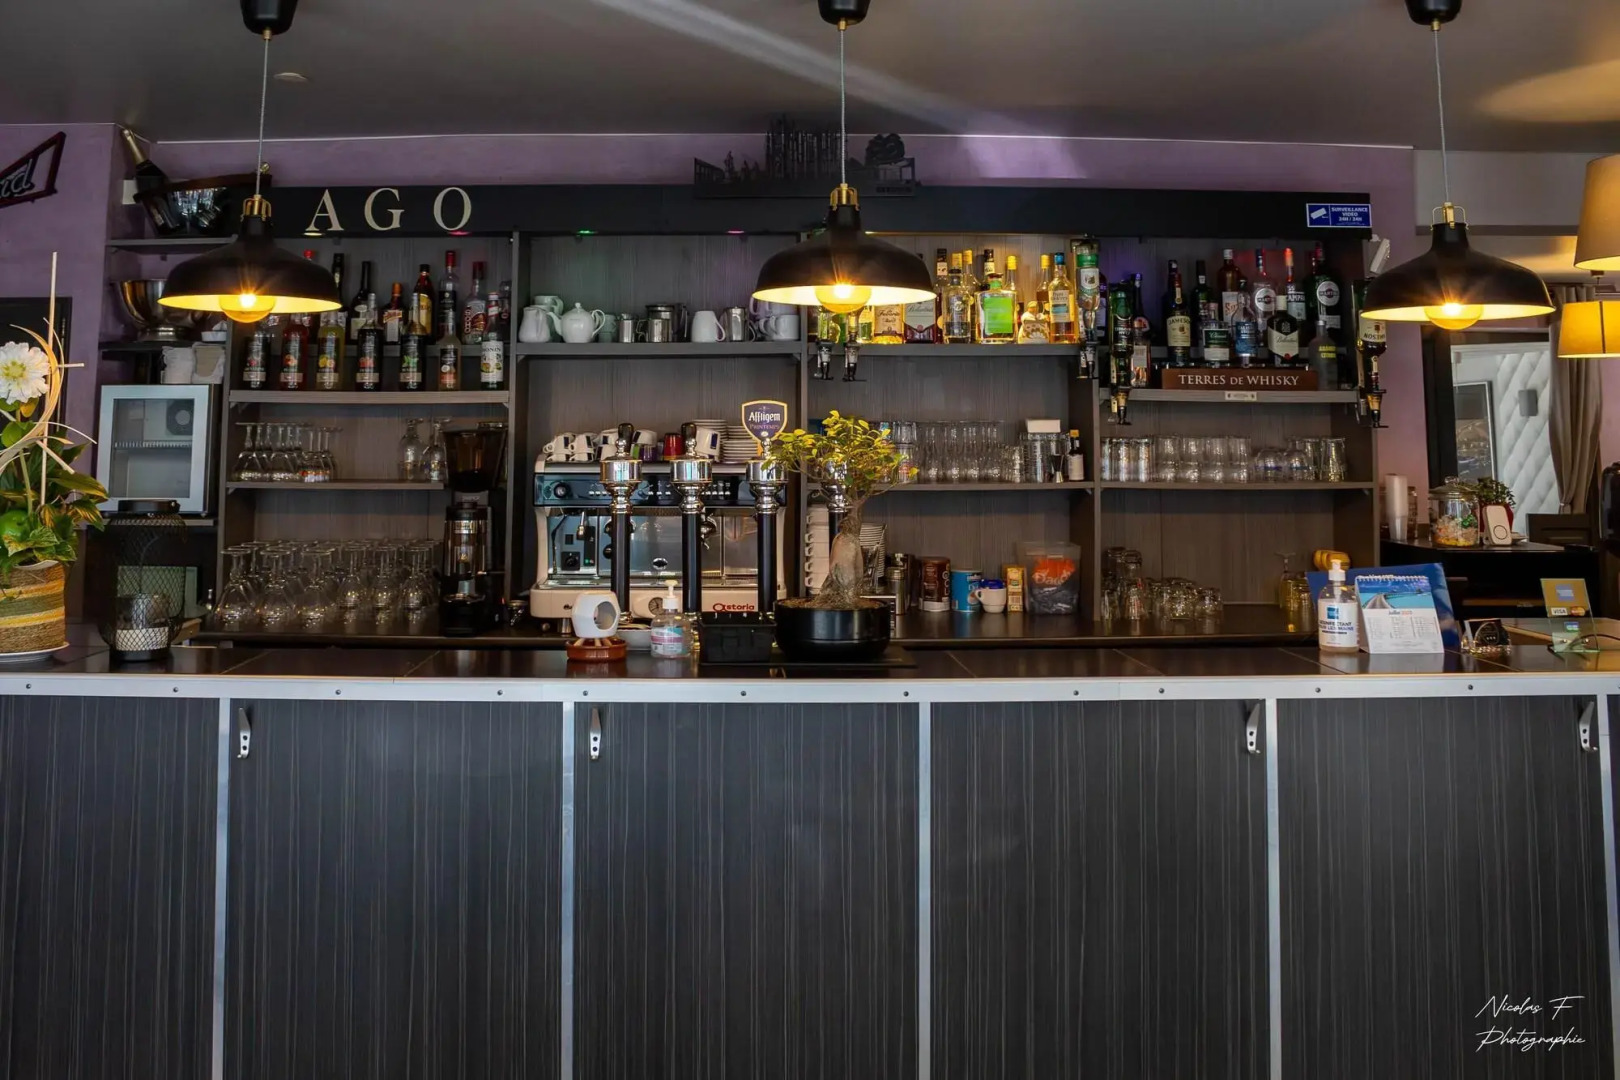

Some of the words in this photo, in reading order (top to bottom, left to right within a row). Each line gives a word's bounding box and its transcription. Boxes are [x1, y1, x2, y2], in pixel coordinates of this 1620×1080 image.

[1178, 374, 1226, 385] TERRES
[1246, 376, 1299, 386] WHISKY
[749, 412, 780, 423] Affligem
